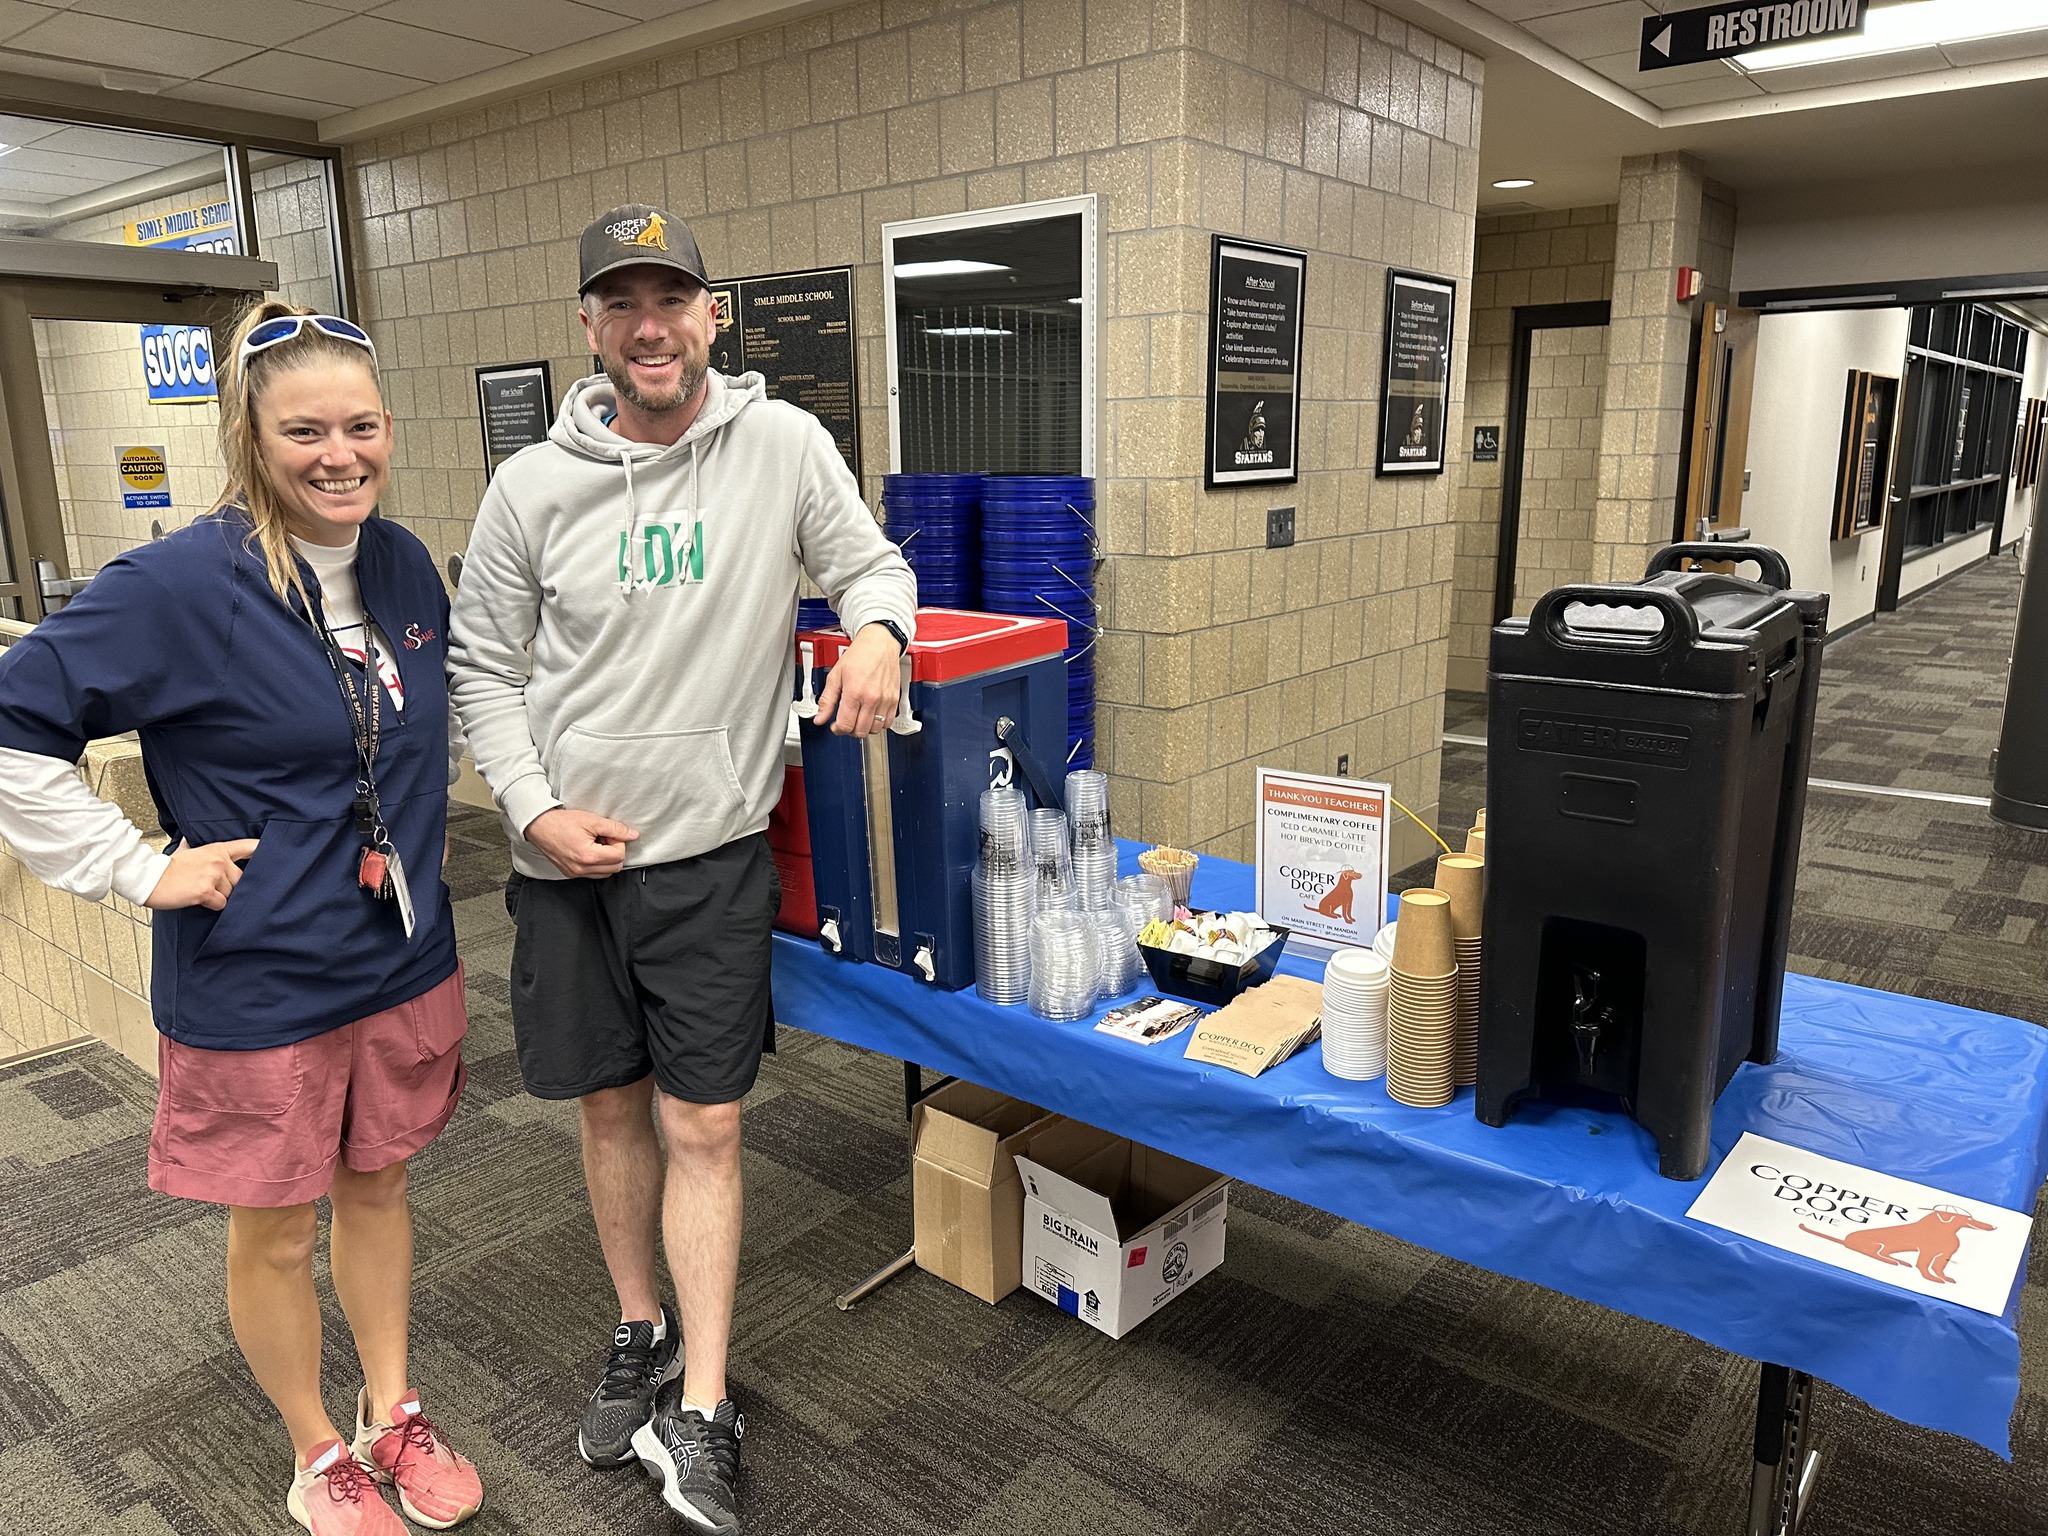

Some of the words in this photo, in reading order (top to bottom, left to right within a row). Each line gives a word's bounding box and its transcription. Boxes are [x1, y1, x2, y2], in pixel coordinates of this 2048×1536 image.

[1706, 0, 1860, 51] RESTROOM
[136, 218, 164, 241] SIMLE
[164, 209, 200, 235] MIDDLE
[604, 218, 648, 234] COPPER
[613, 226, 640, 239] DOG
[1245, 275, 1258, 287] After
[1259, 278, 1276, 289] School
[754, 296, 775, 306] SIMLE
[776, 293, 803, 304] MIDDLE
[805, 290, 834, 302] SCHOOL
[144, 327, 217, 388] SUCC
[721, 351, 730, 369] 2
[1235, 450, 1273, 464] SPARTANS
[1399, 446, 1427, 457] SPARTANS
[121, 463, 164, 473] CAUTION
[344, 671, 358, 700] SIMLE
[371, 684, 380, 732] SPARTANS
[1520, 719, 1618, 750] CATER
[1625, 736, 1680, 754] GATOR
[1268, 789, 1300, 801] THANK
[1301, 794, 1322, 804] YOU
[1324, 797, 1378, 813] TEACHERS!
[1267, 808, 1341, 826] COMPLIMENTARY
[1342, 819, 1378, 832] COFFEE
[1280, 822, 1299, 831] ICED
[1301, 825, 1339, 838] CARAMEL
[1341, 831, 1366, 843] LATTE
[1280, 832, 1297, 840] HOT
[1299, 835, 1333, 847] BREWED
[1334, 841, 1366, 853] COFFEE
[1279, 865, 1335, 886] COPPER
[1291, 878, 1324, 895] DOG
[1299, 892, 1316, 900] CAFE
[1290, 917, 1305, 925] MAIN
[1306, 920, 1326, 928] STREET
[1334, 926, 1358, 935] MANDAN
[1198, 1031, 1239, 1045] COPPER
[1240, 1041, 1266, 1056] DOG
[1750, 1163, 1909, 1222] COPPER
[1773, 1185, 1872, 1225] DOG
[1792, 1206, 1840, 1227] CAFE
[1043, 1213, 1062, 1232] BIG
[1063, 1224, 1098, 1252] TRAIN
